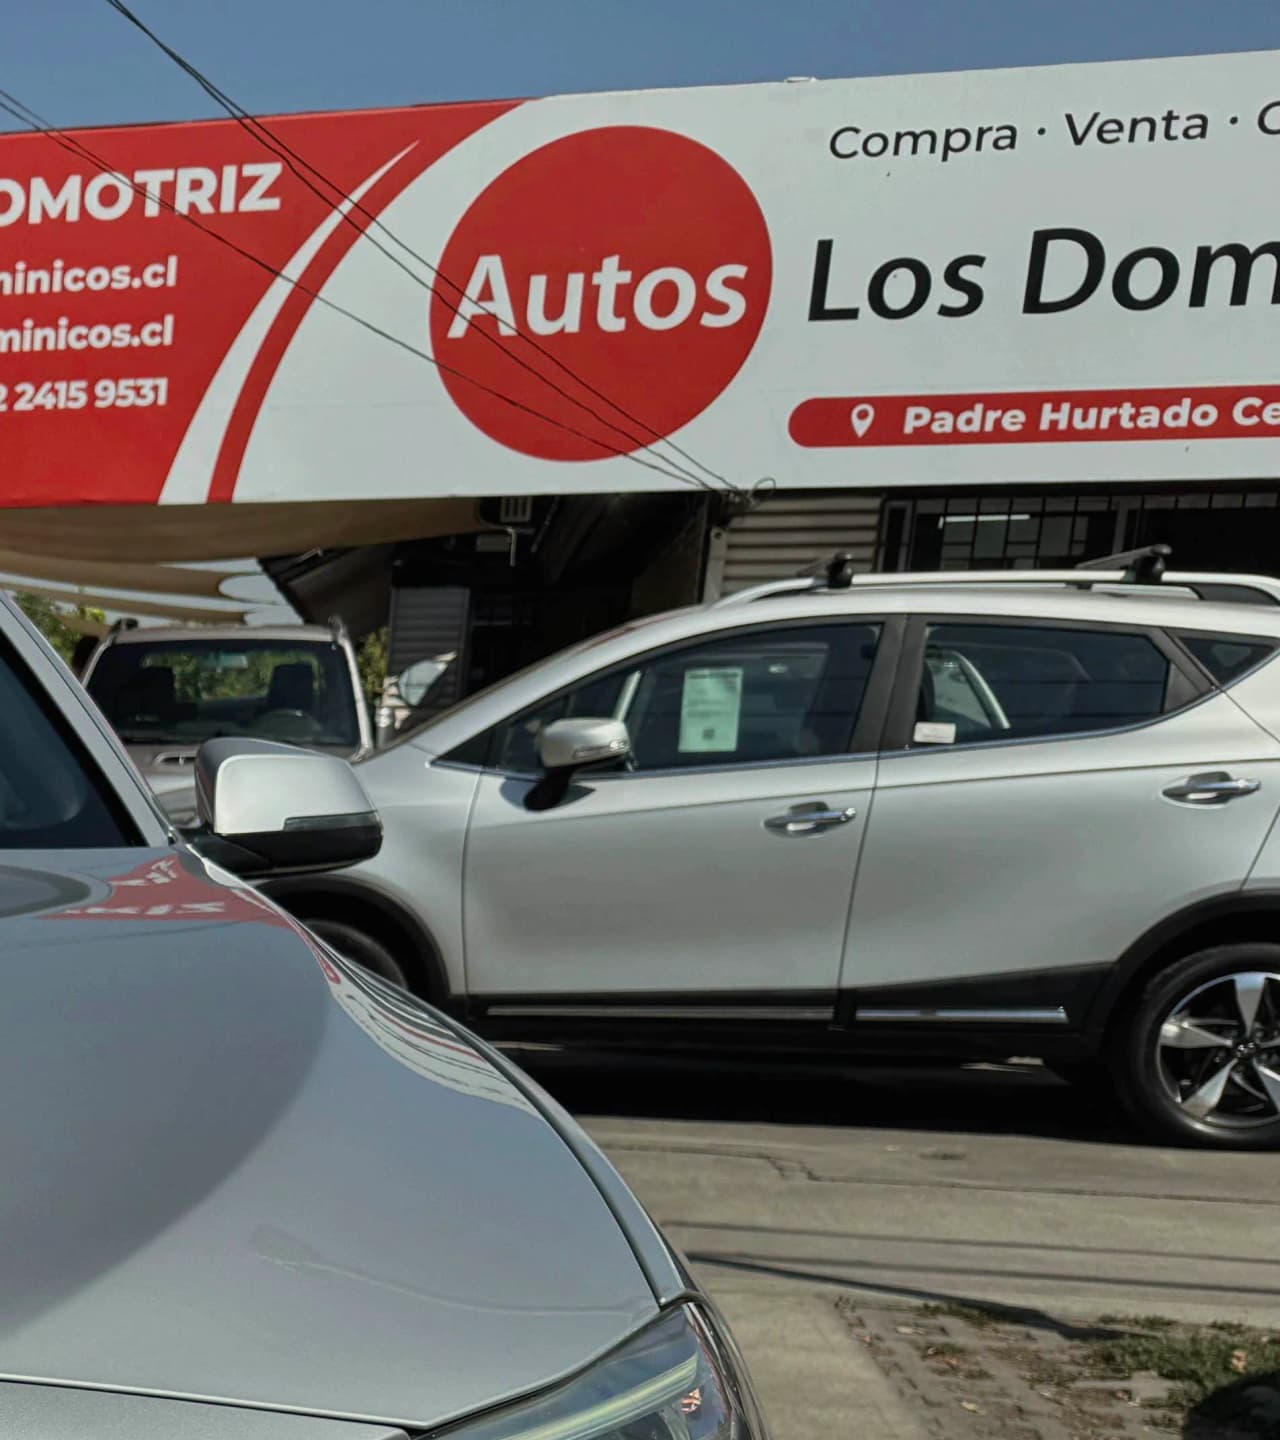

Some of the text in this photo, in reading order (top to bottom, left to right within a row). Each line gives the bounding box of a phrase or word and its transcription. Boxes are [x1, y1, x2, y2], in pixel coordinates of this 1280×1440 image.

[828, 123, 1019, 163] Compra
[1064, 109, 1210, 147] Venta
[447, 254, 749, 338] Autos
[806, 226, 1280, 323] Los Dom
[12, 380, 89, 411] 2415
[94, 377, 169, 409] 9531
[902, 403, 1026, 435] Padre
[1039, 396, 1218, 432] Hurtado
